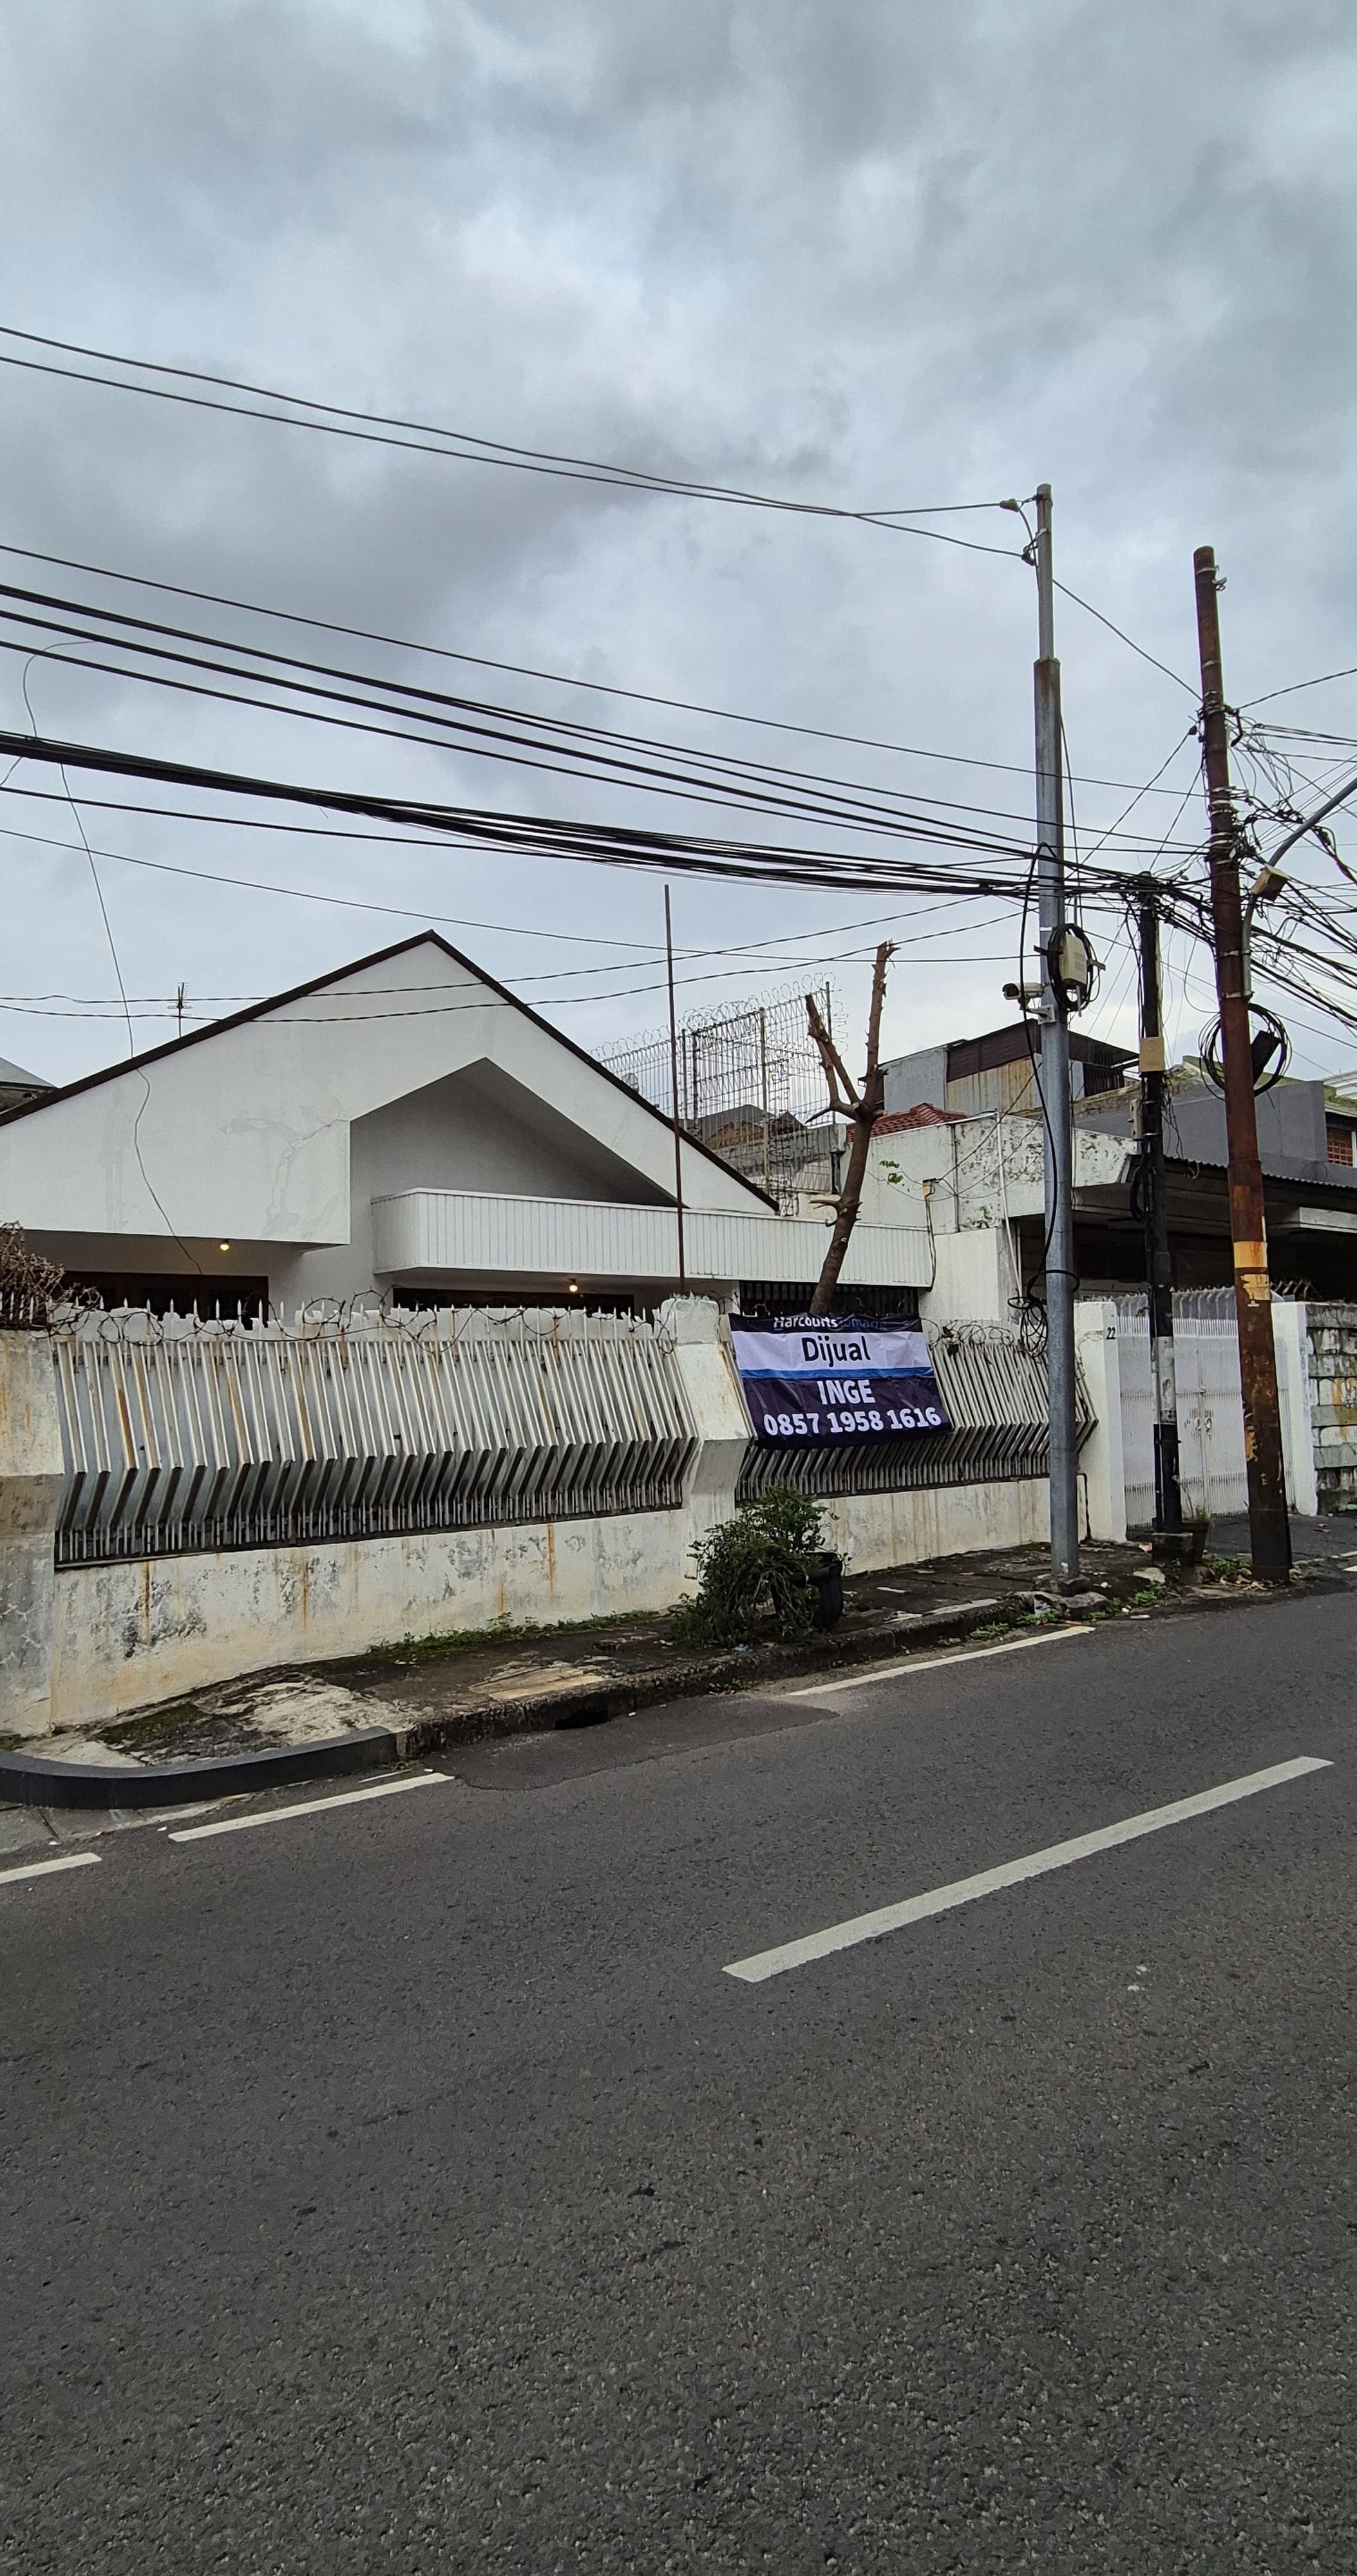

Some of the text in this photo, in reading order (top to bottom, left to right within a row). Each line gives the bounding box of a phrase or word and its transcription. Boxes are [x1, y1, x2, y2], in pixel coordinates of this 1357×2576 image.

[773, 1316, 837, 1329] Harcourts
[1106, 1327, 1115, 1340] 22
[801, 1335, 871, 1367] Dijual
[817, 1379, 876, 1405] INGE
[764, 1406, 942, 1435] 0857 1958 1616
